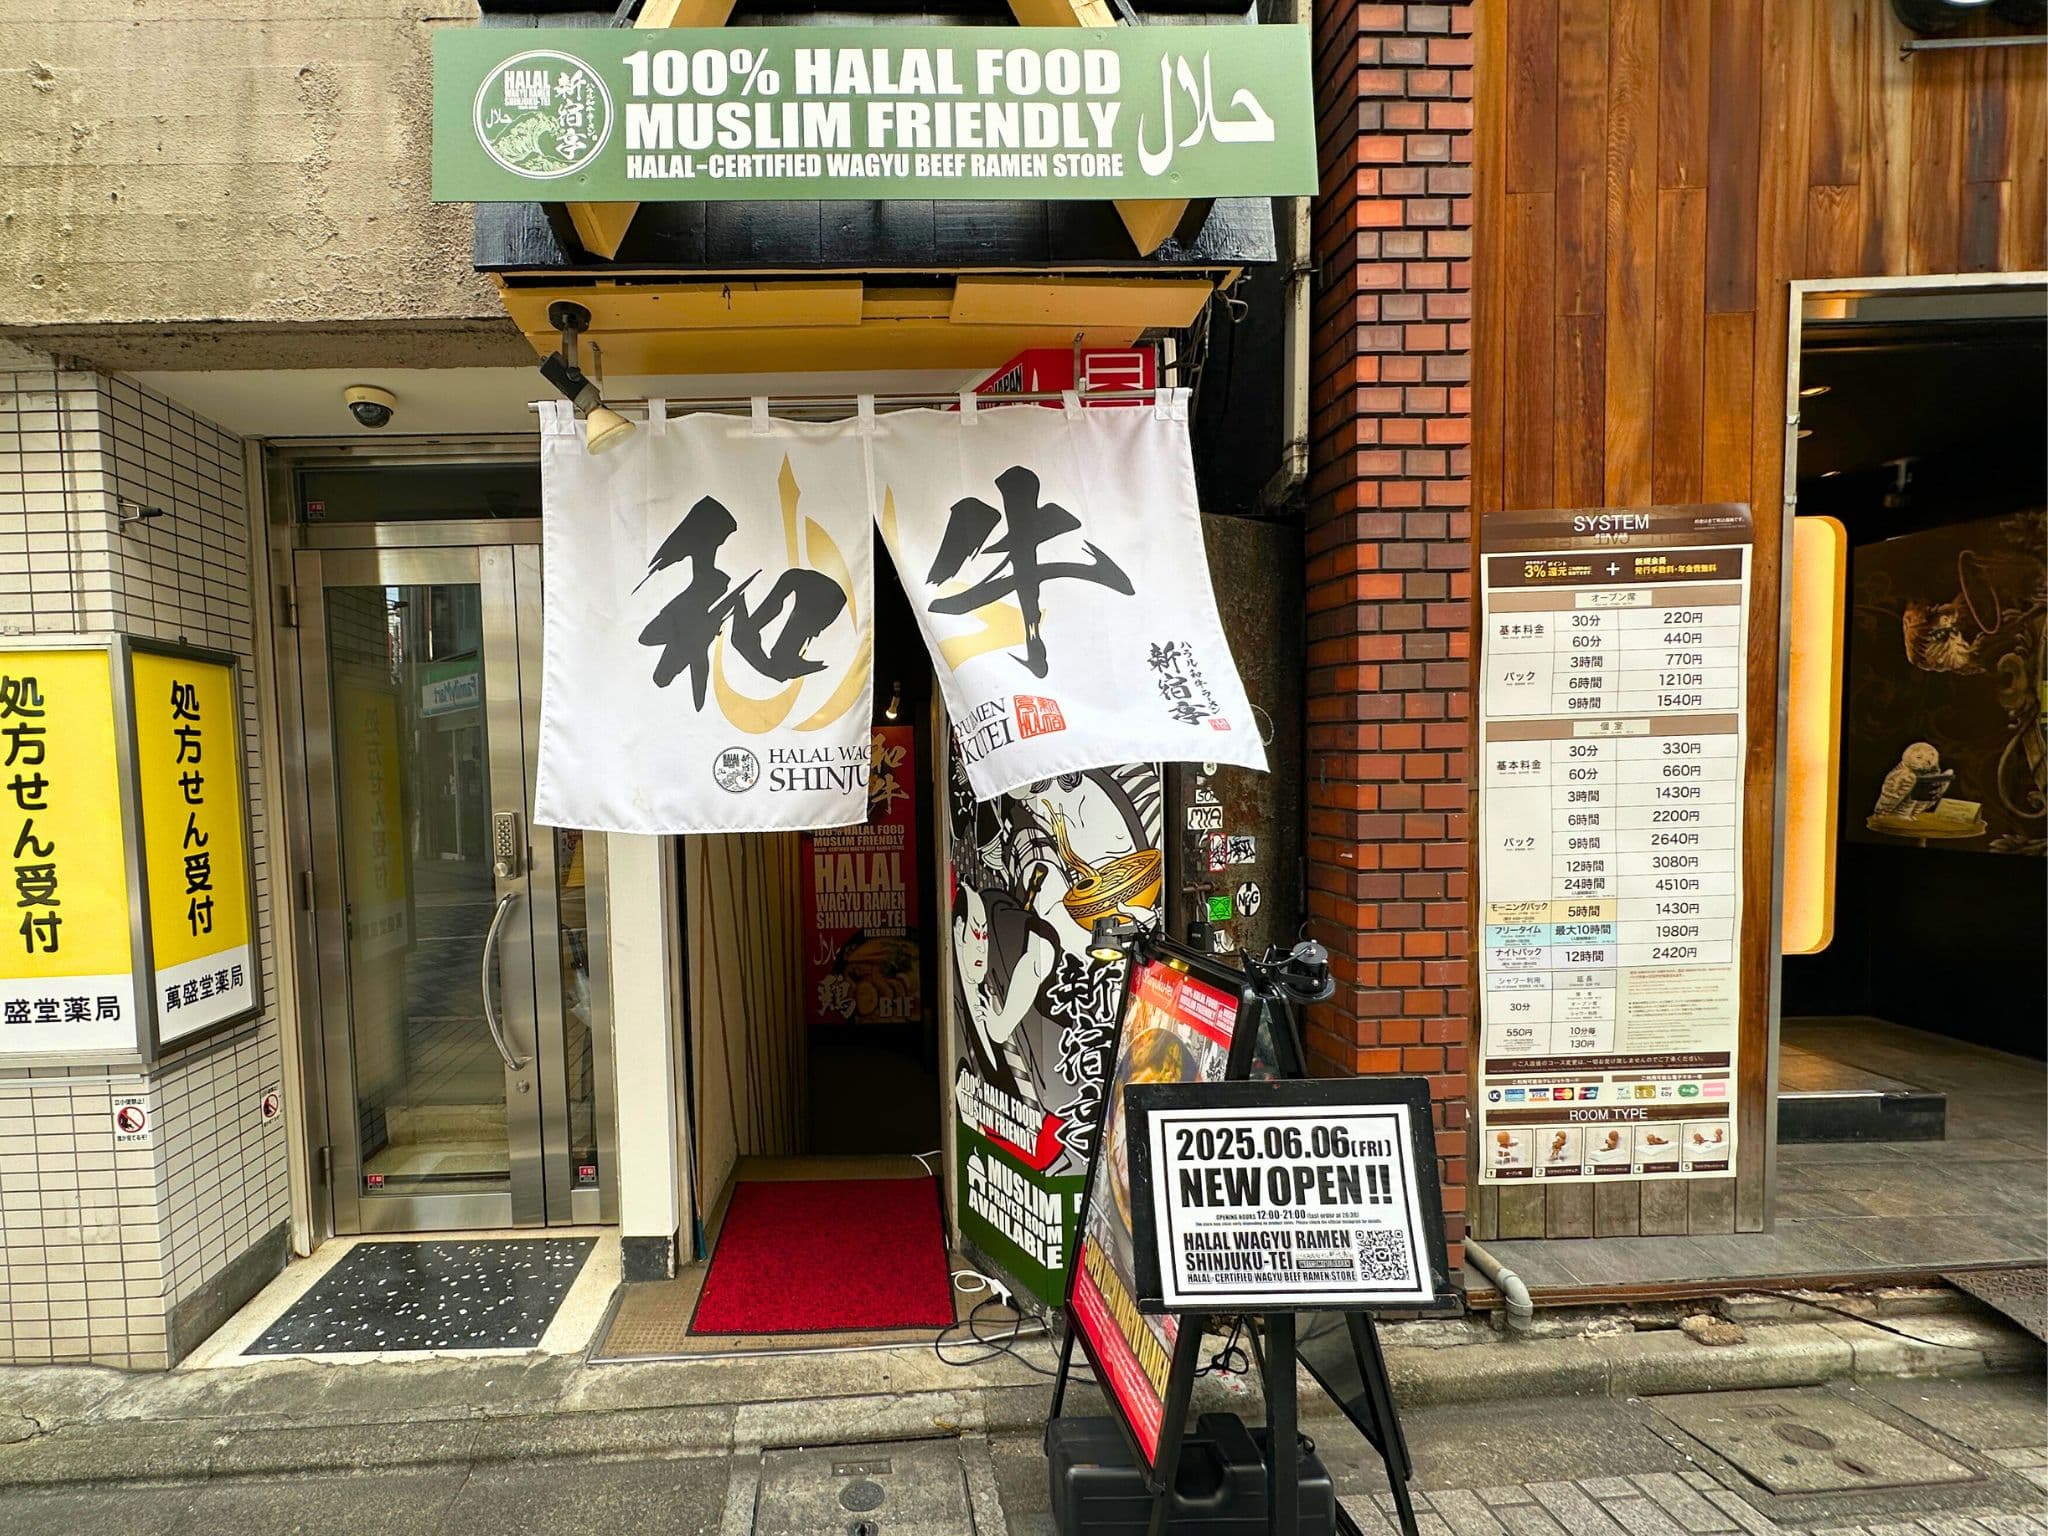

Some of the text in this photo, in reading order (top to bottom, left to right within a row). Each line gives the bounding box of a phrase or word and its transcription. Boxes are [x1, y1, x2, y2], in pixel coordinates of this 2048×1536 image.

[504, 70, 550, 88] HALAL
[622, 48, 1121, 97] 100% HALAL FOOD
[1138, 51, 1276, 176] حلال
[624, 101, 1122, 151] MUSLIM FRIENDLY
[626, 153, 1124, 180] HALAL-CERTIFIED WAGYU BEEF RAMEN STORE
[1573, 514, 1649, 532] SYSTEM
[1524, 565, 1546, 577] 3%
[1570, 611, 1703, 628] 30分 220円
[1498, 623, 1545, 636] 基本料金
[1571, 632, 1702, 648] 60分 440円
[1569, 653, 1703, 668] 3時間 770円
[1568, 673, 1703, 690] 6時間 1210円
[1567, 693, 1702, 710] 9時間 1540円
[768, 747, 835, 764] HALAL
[1568, 741, 1702, 758] 30分 330円
[1496, 759, 1542, 771] 基本料金
[1568, 764, 1702, 781] 60分 660円
[1566, 786, 1702, 803] 3時間 1430円
[0, 675, 63, 954] 処方せん受付
[170, 680, 214, 937] 処方せん受付
[1567, 809, 1700, 826] 6時間 2200円
[878, 825, 905, 835] FOOD
[814, 835, 905, 848] MUSLIM FRIENDLY
[1567, 832, 1699, 850] 9時間 2640円
[1565, 855, 1699, 872] 12時間 3080円
[815, 852, 906, 893] HALAL
[1564, 877, 1699, 891] 24時間 4510円
[816, 891, 905, 911] WAGYU RAMEN
[1567, 902, 1700, 918] 5時間 1430円
[816, 911, 906, 929] SHINJUKU-TEI
[1495, 925, 1541, 935] フリータイム
[1554, 923, 1699, 938] 最大10時間 1980円
[1565, 946, 1697, 963] 12時間 2420円
[165, 965, 245, 1013] 萬盛堂薬局
[3, 996, 122, 1025] 盛堂薬局
[1509, 1002, 1531, 1012] 30分
[1506, 1028, 1533, 1037] 550円
[1570, 1039, 1596, 1049] 130円
[984, 1081, 1011, 1119] HALAL
[1489, 1091, 1501, 1100] UC
[961, 1089, 1038, 1157] MUSLIM FRIENDLY
[1568, 1108, 1648, 1122] ROOM TYPE
[1537, 1168, 1543, 1176] 2
[1635, 1165, 1641, 1173] 4
[1684, 1163, 1690, 1171] 5
[987, 1154, 1063, 1225] MUSLIM
[1179, 1166, 1261, 1208] NEW
[987, 1183, 1063, 1244] PRAYER ROOM
[1256, 1209, 1306, 1221] 12:00-21:00
[968, 1186, 1063, 1270] AVAILABLE
[1183, 1229, 1352, 1251] HALAL WAGYU RAMEN
[1185, 1251, 1294, 1271] SHINJUKU-TEI
[1254, 1272, 1282, 1282] WAGYU
[1284, 1271, 1302, 1282] BEEF
[1303, 1271, 1330, 1282] RAMEN
[1331, 1270, 1357, 1281] STORE
